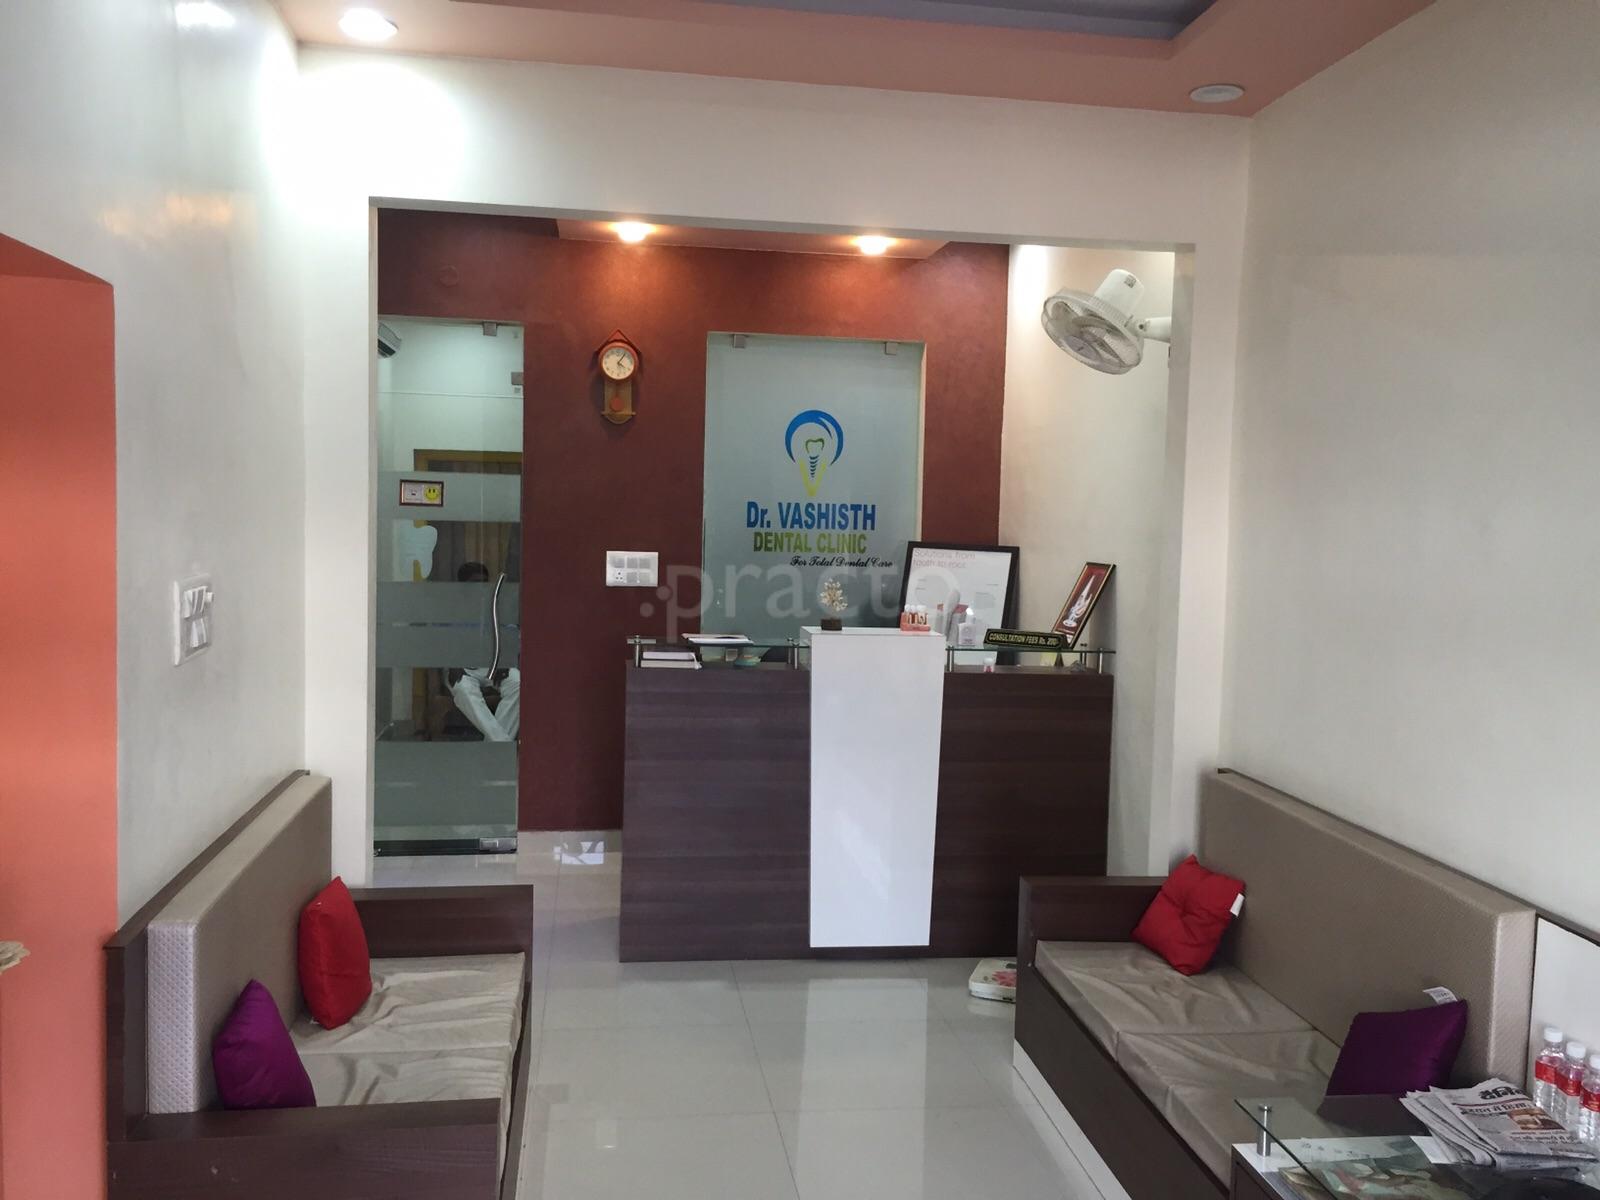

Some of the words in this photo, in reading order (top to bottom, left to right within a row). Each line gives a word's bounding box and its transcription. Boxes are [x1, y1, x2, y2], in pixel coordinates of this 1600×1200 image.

[746, 501, 771, 529] Dr.
[778, 502, 876, 531] VASHISTH
[753, 531, 812, 553] DENTAL
[816, 533, 868, 554] CLINIC
[790, 556, 807, 567] For
[809, 556, 835, 567] Total
[836, 557, 868, 568] Dental
[870, 558, 893, 568] Care
[989, 632, 1025, 643] CONSULTATION
